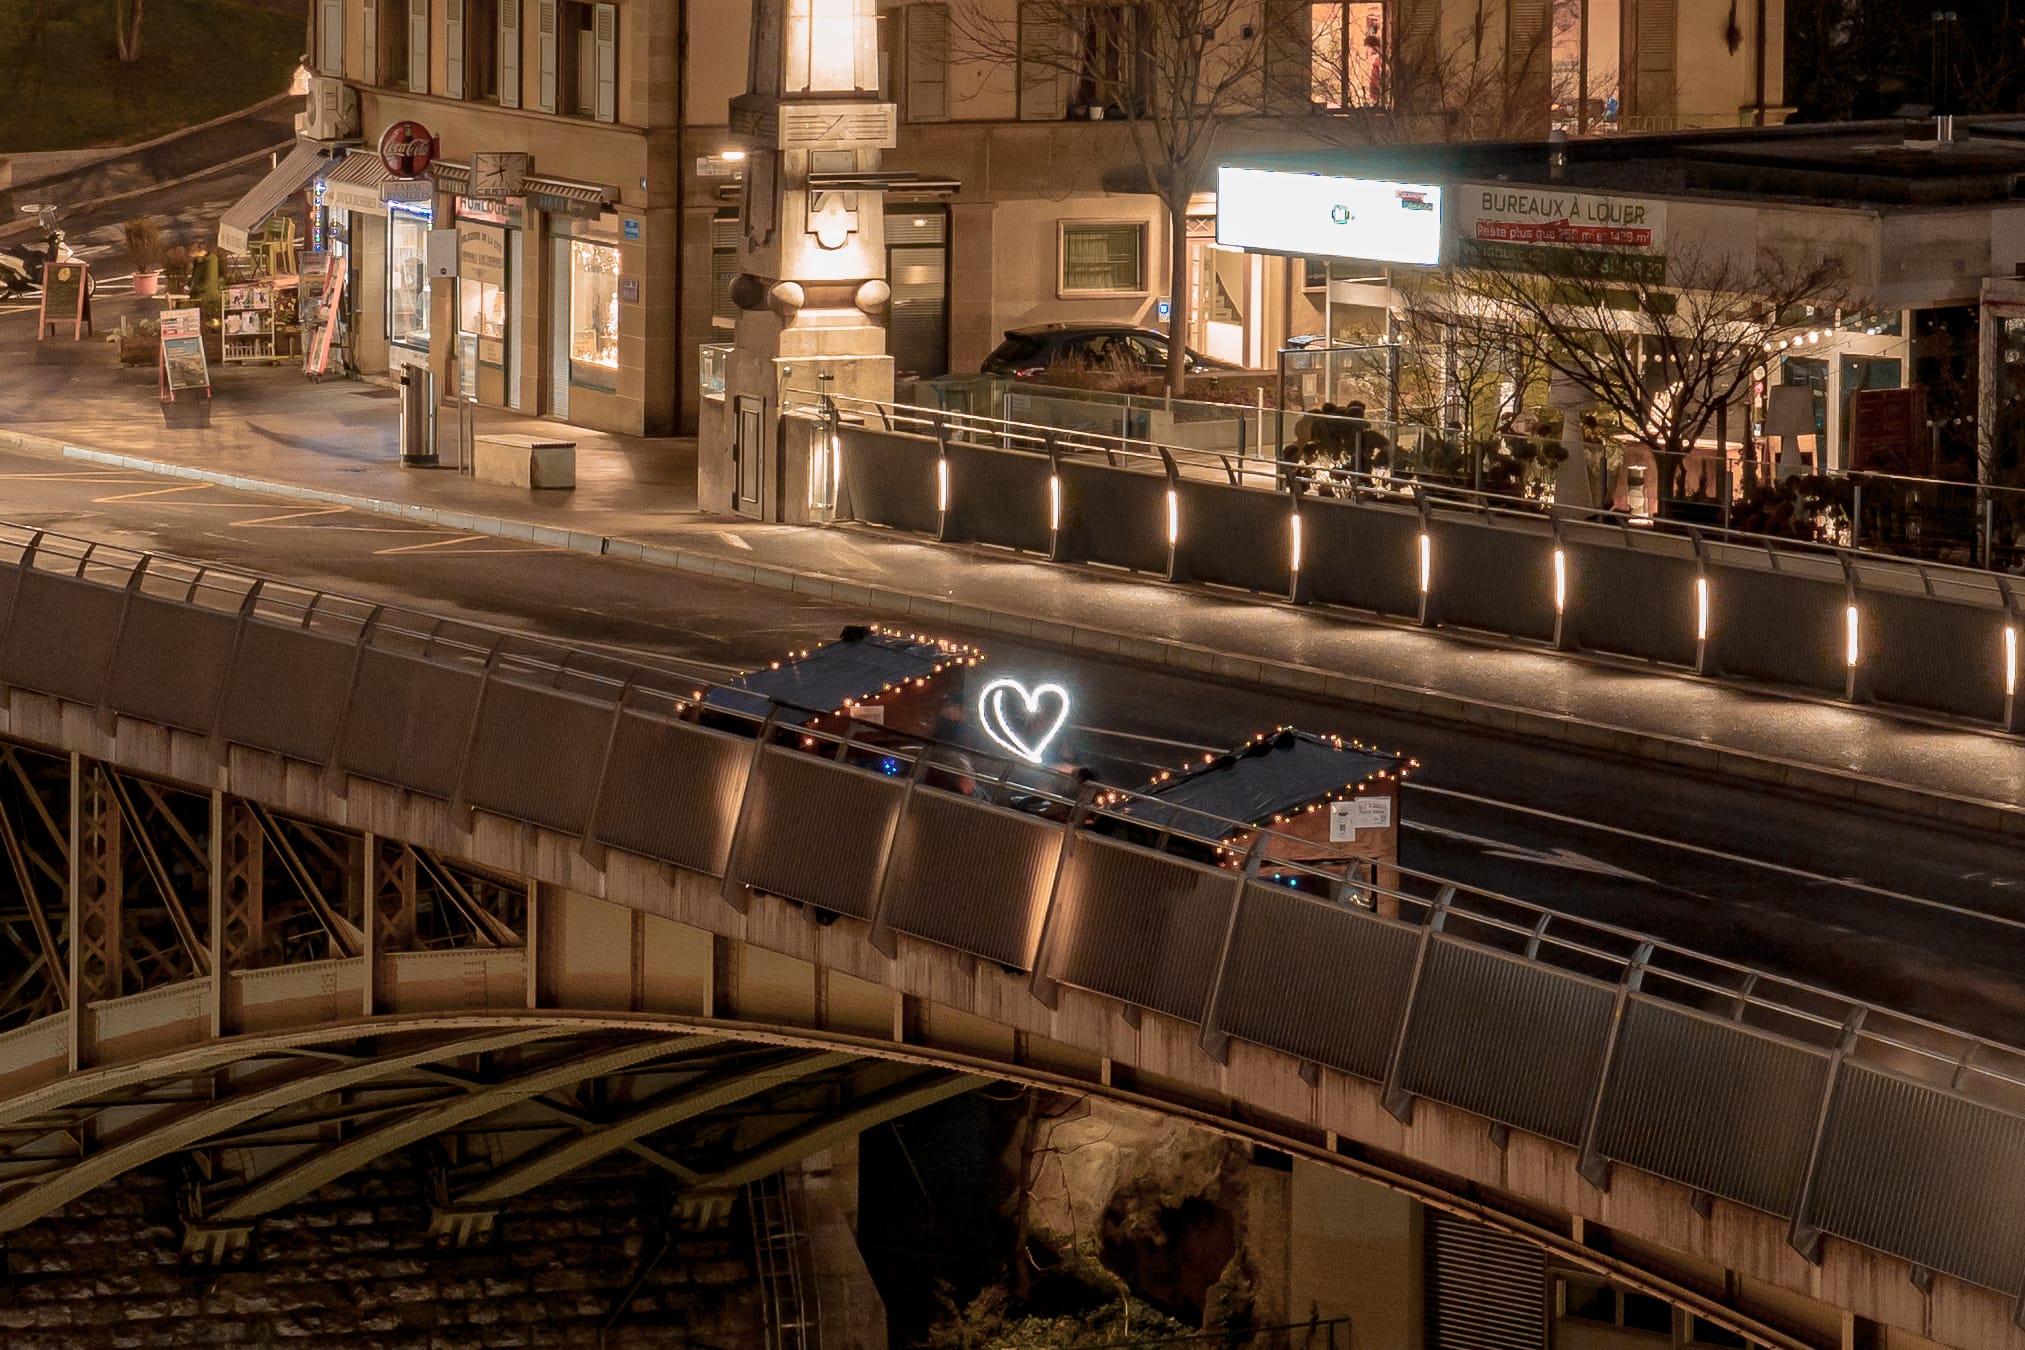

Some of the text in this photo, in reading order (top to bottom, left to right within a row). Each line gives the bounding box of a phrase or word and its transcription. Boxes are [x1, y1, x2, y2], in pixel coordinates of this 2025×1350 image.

[478, 187, 525, 196] CERTINA
[1482, 192, 1645, 224] BUREAUX À LOUER
[1477, 223, 1506, 238] Reste
[1509, 226, 1533, 239] plus
[1535, 230, 1556, 240] que
